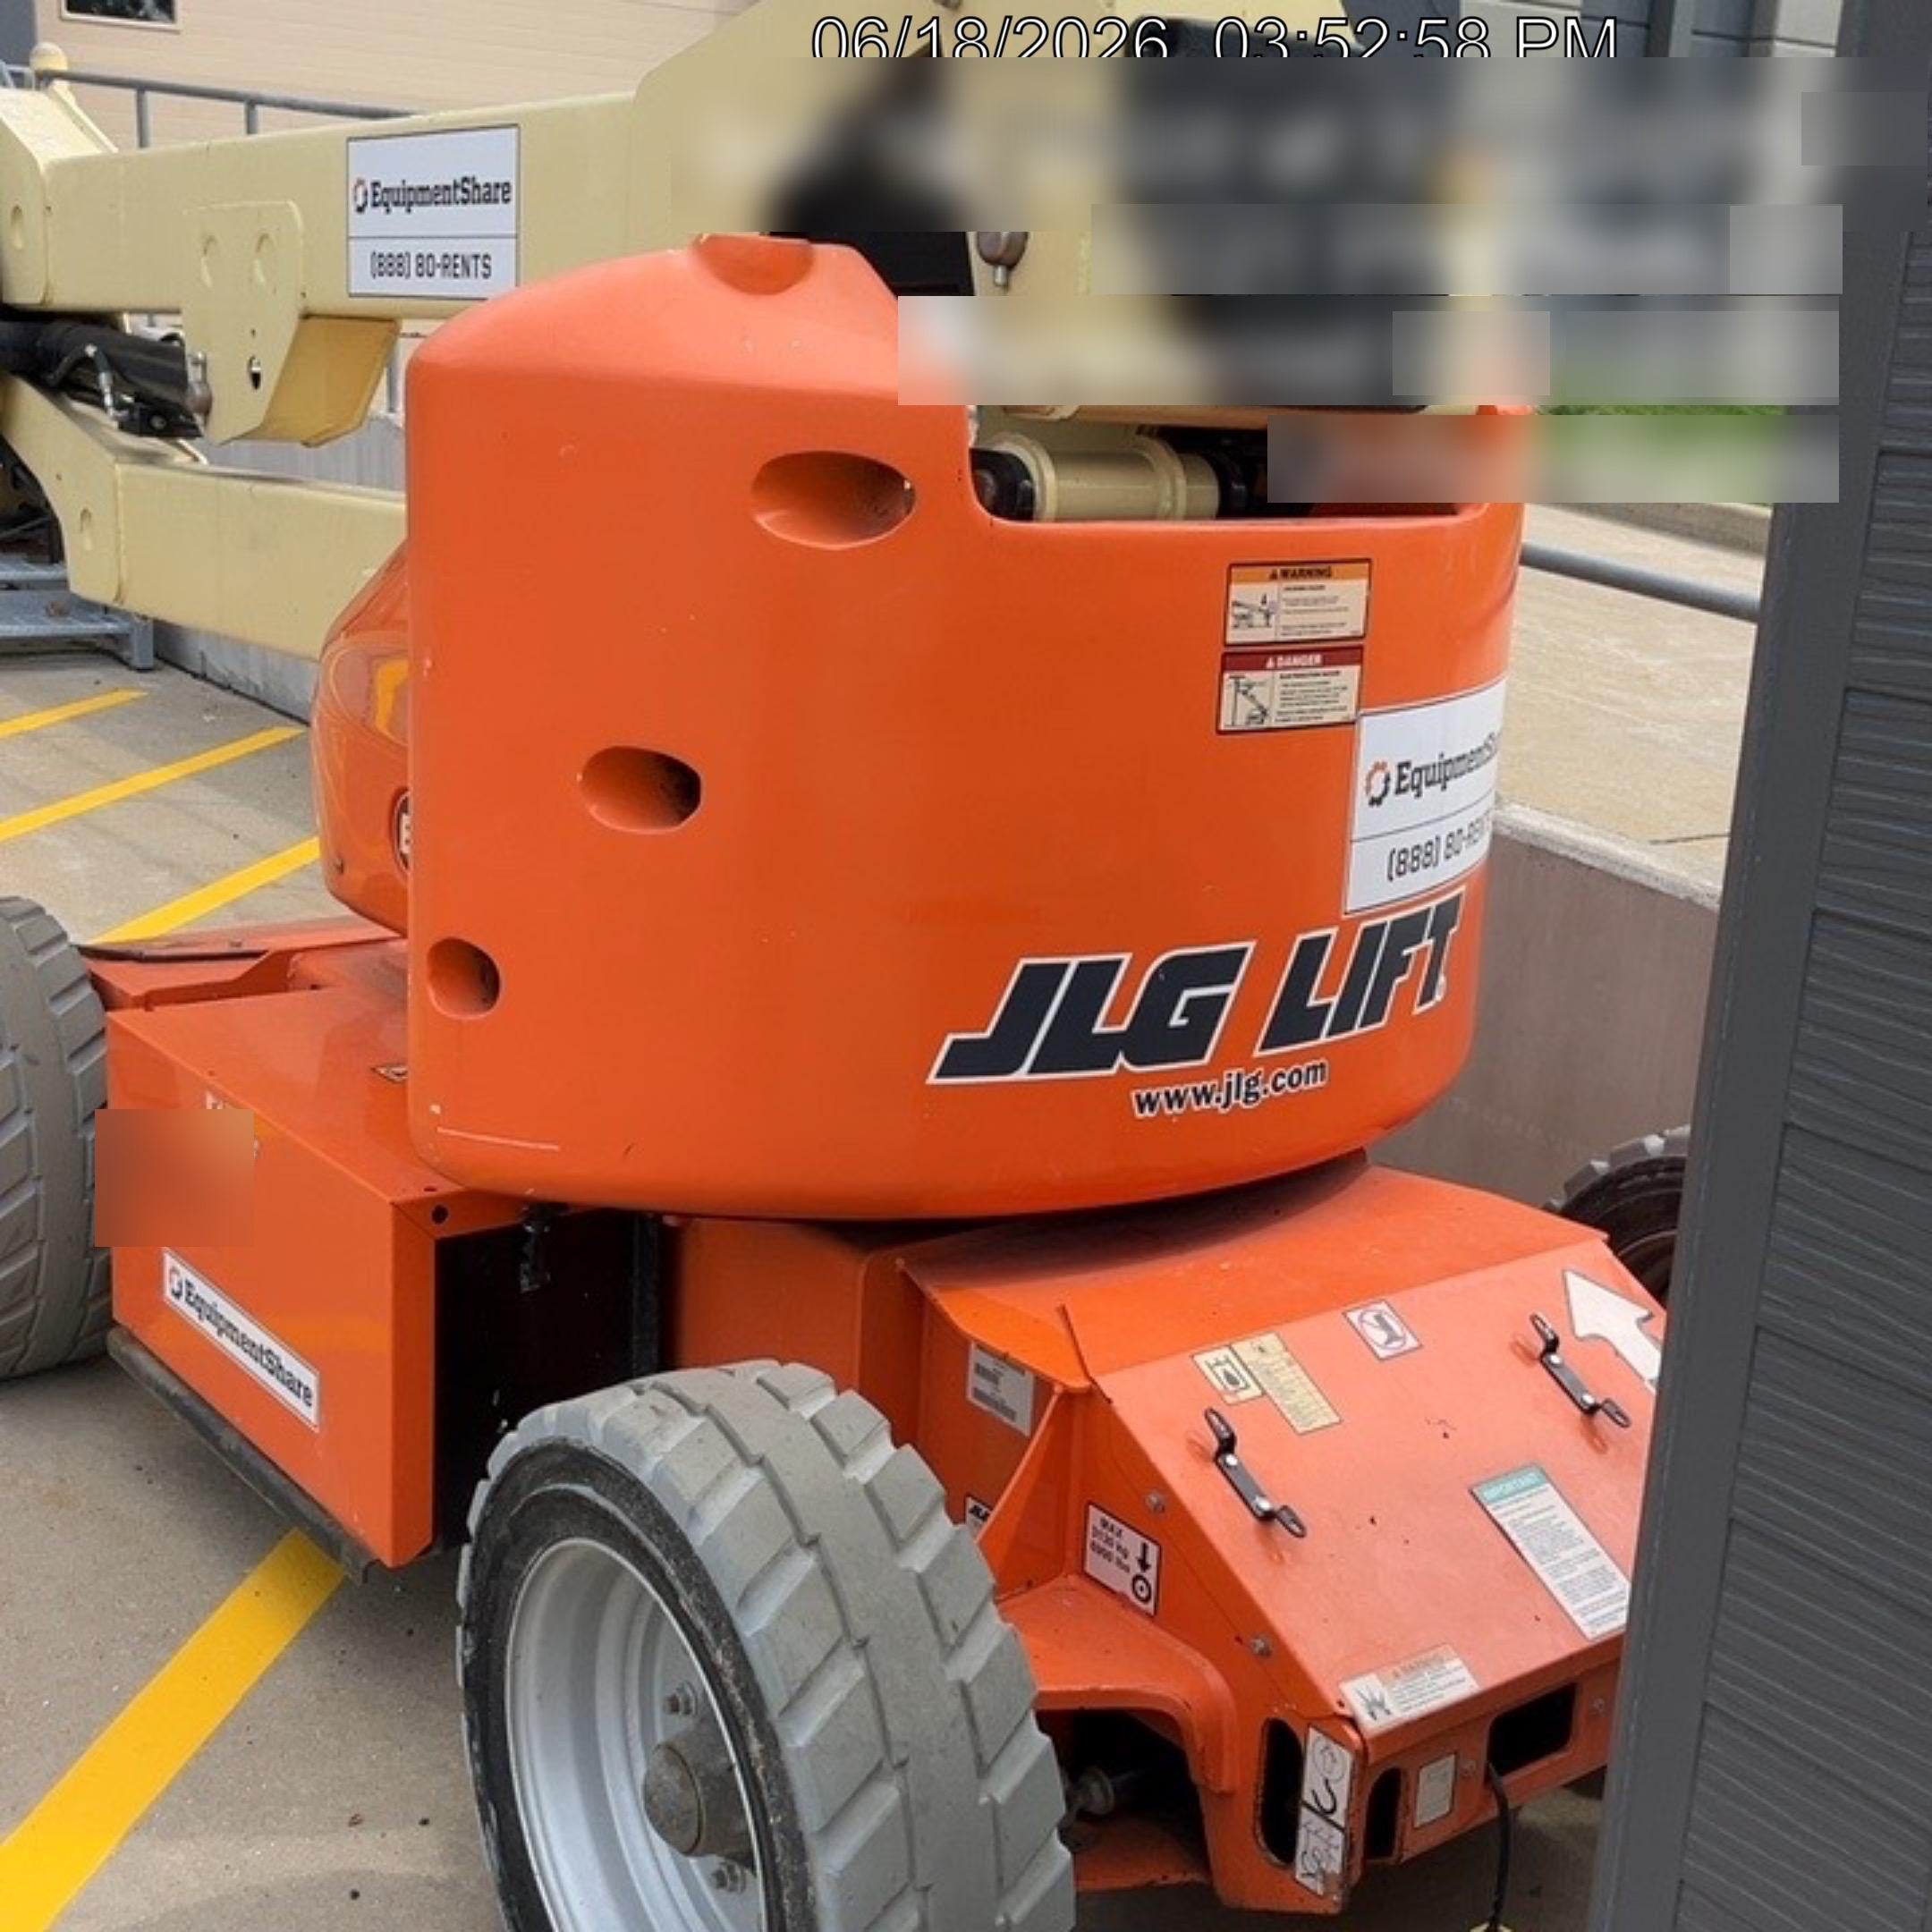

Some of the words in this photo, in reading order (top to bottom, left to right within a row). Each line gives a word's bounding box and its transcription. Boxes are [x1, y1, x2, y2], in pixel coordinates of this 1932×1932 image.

[370, 175, 512, 214] EquipmentShare
[370, 251, 411, 279] (888)
[415, 252, 492, 279] 80-RENTS
[1276, 654, 1323, 667] DANGER
[1386, 835, 1441, 883] (888)
[927, 940, 1256, 1084] JLG
[1253, 885, 1465, 1058] LIFT
[1133, 1060, 1328, 1116] www.jlg.com
[184, 1278, 313, 1408] EquipmentShare
